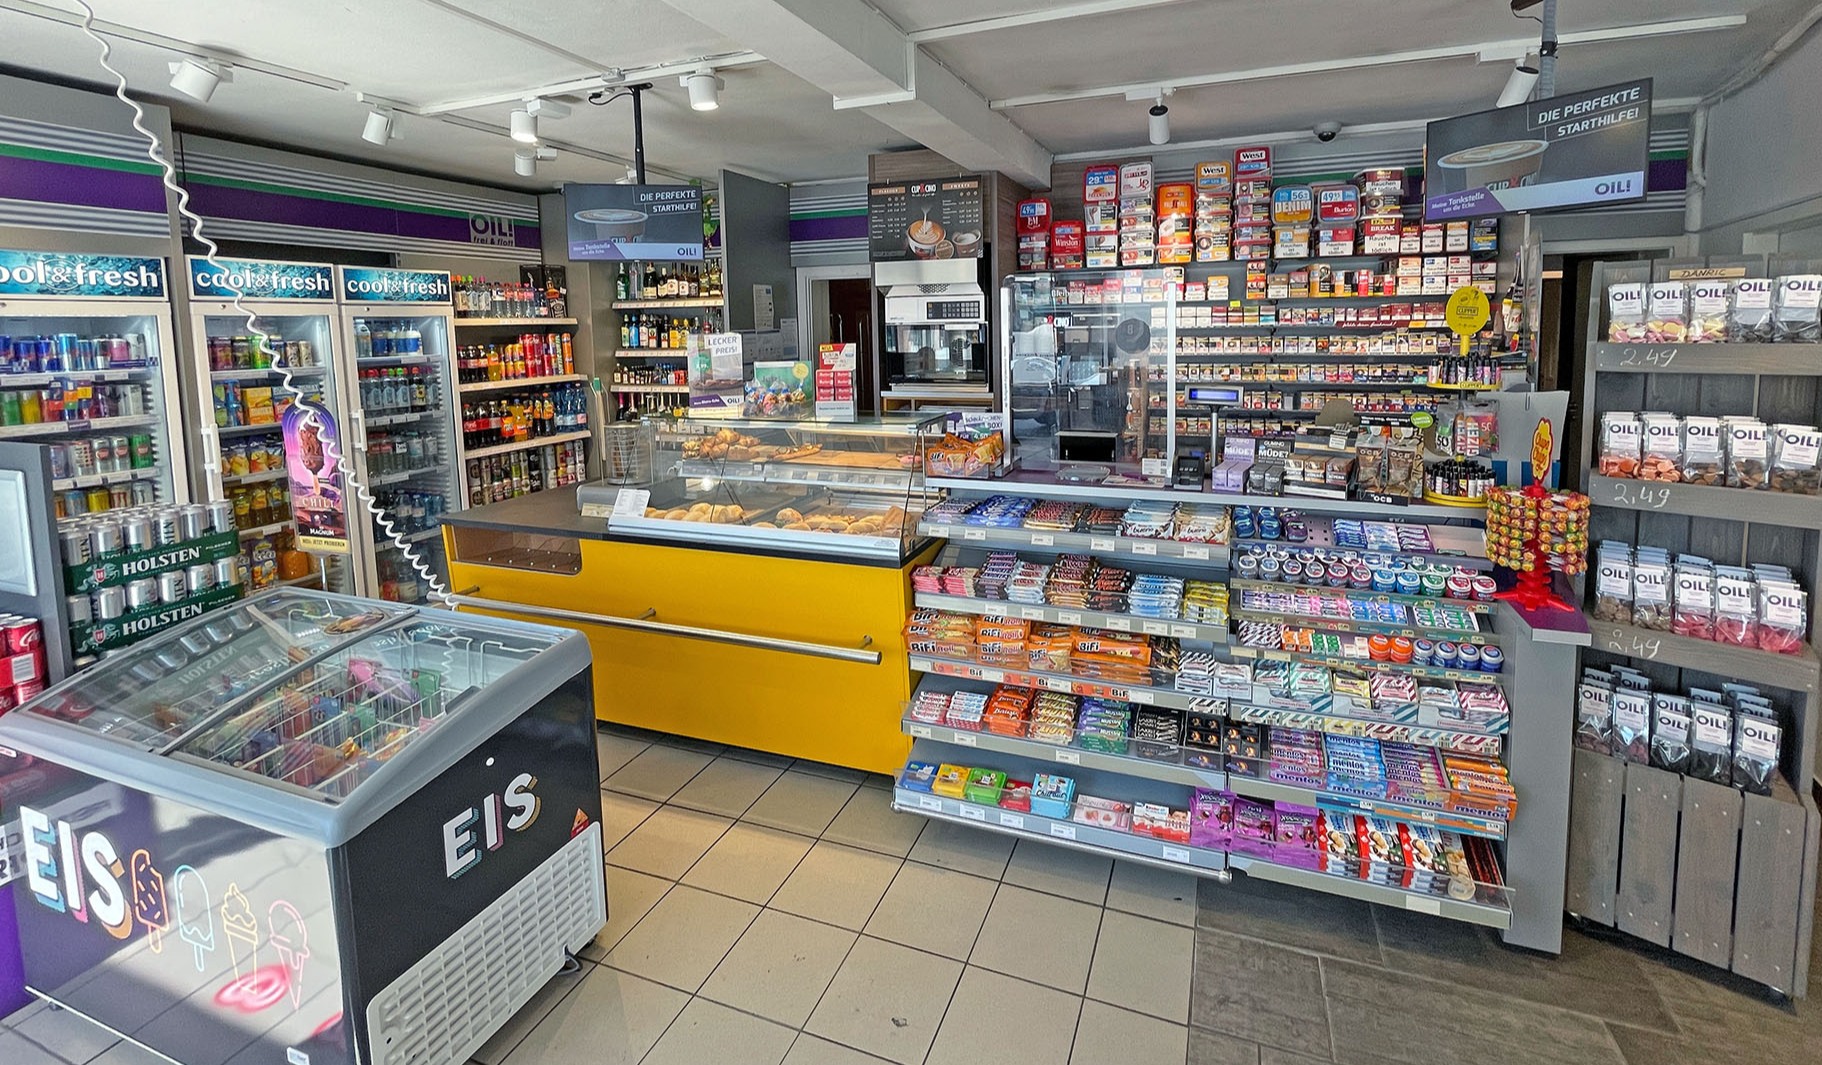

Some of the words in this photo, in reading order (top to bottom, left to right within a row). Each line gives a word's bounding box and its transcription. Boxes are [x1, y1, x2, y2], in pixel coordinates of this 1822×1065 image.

[1538, 108, 1561, 124] DIE
[1564, 87, 1640, 117] PERFEKTE
[1557, 107, 1639, 137] STARTHILFE!
[1242, 152, 1263, 160] West
[1594, 180, 1631, 194] OIL!
[640, 193, 653, 201] DIE
[655, 190, 696, 200] PERFEKTE
[1449, 191, 1485, 206] Tankstelle
[652, 203, 697, 213] STARTHILFE!
[1274, 201, 1311, 213] DENIM
[470, 213, 513, 237] OIL!
[1056, 239, 1079, 247] Winston
[677, 247, 697, 256] OIL!
[0, 260, 158, 288] ol&fresh
[196, 268, 330, 292] cool&fresh
[347, 275, 448, 295] cool&fresh
[1739, 282, 1771, 291] OIL!
[1786, 279, 1822, 291] OIL!
[1613, 291, 1640, 301] OIL!
[1653, 289, 1682, 299] OIL!
[1696, 287, 1726, 298] OIL!
[708, 336, 737, 346] LECKER
[715, 347, 737, 355] PREIS!
[1610, 424, 1637, 434] OIL!
[1649, 426, 1679, 436] OIL!
[1688, 426, 1718, 436] OIL!
[1733, 429, 1766, 440] OIL!
[1467, 421, 1479, 457] GIZEH
[1785, 434, 1821, 447] OIL!
[1259, 448, 1288, 458] MÜDE?
[1373, 495, 1392, 503] OCB
[1133, 525, 1154, 533] bueno
[1187, 526, 1207, 534] bueno
[122, 546, 200, 576] HOLSTEN
[1602, 567, 1629, 579] OIL!
[1636, 573, 1665, 584] OIL!
[1680, 579, 1710, 591] OIL!
[1719, 585, 1750, 597] OIL!
[1768, 595, 1801, 608] OIL!
[122, 602, 203, 636] HOLSTEN
[981, 628, 1000, 637] BiFi
[911, 642, 936, 652] BiFi
[1079, 641, 1099, 652] BiFi
[1582, 690, 1609, 703] OIL!
[1616, 700, 1645, 714] OIL!
[1657, 699, 1686, 713] OIL!
[1659, 716, 1688, 731] OIL!
[1696, 715, 1726, 730] OIL!
[1743, 727, 1777, 743] OIL!
[1332, 759, 1365, 770] mentos
[1388, 762, 1420, 771] mentos
[1388, 768, 1421, 777] mentos
[1276, 774, 1321, 785] mentos
[1389, 774, 1423, 784] mentos
[1333, 785, 1380, 798] mentos
[1393, 795, 1443, 808] mentos
[1456, 805, 1508, 819] mentos
[443, 773, 541, 880] EIS
[20, 806, 131, 937] EIS
